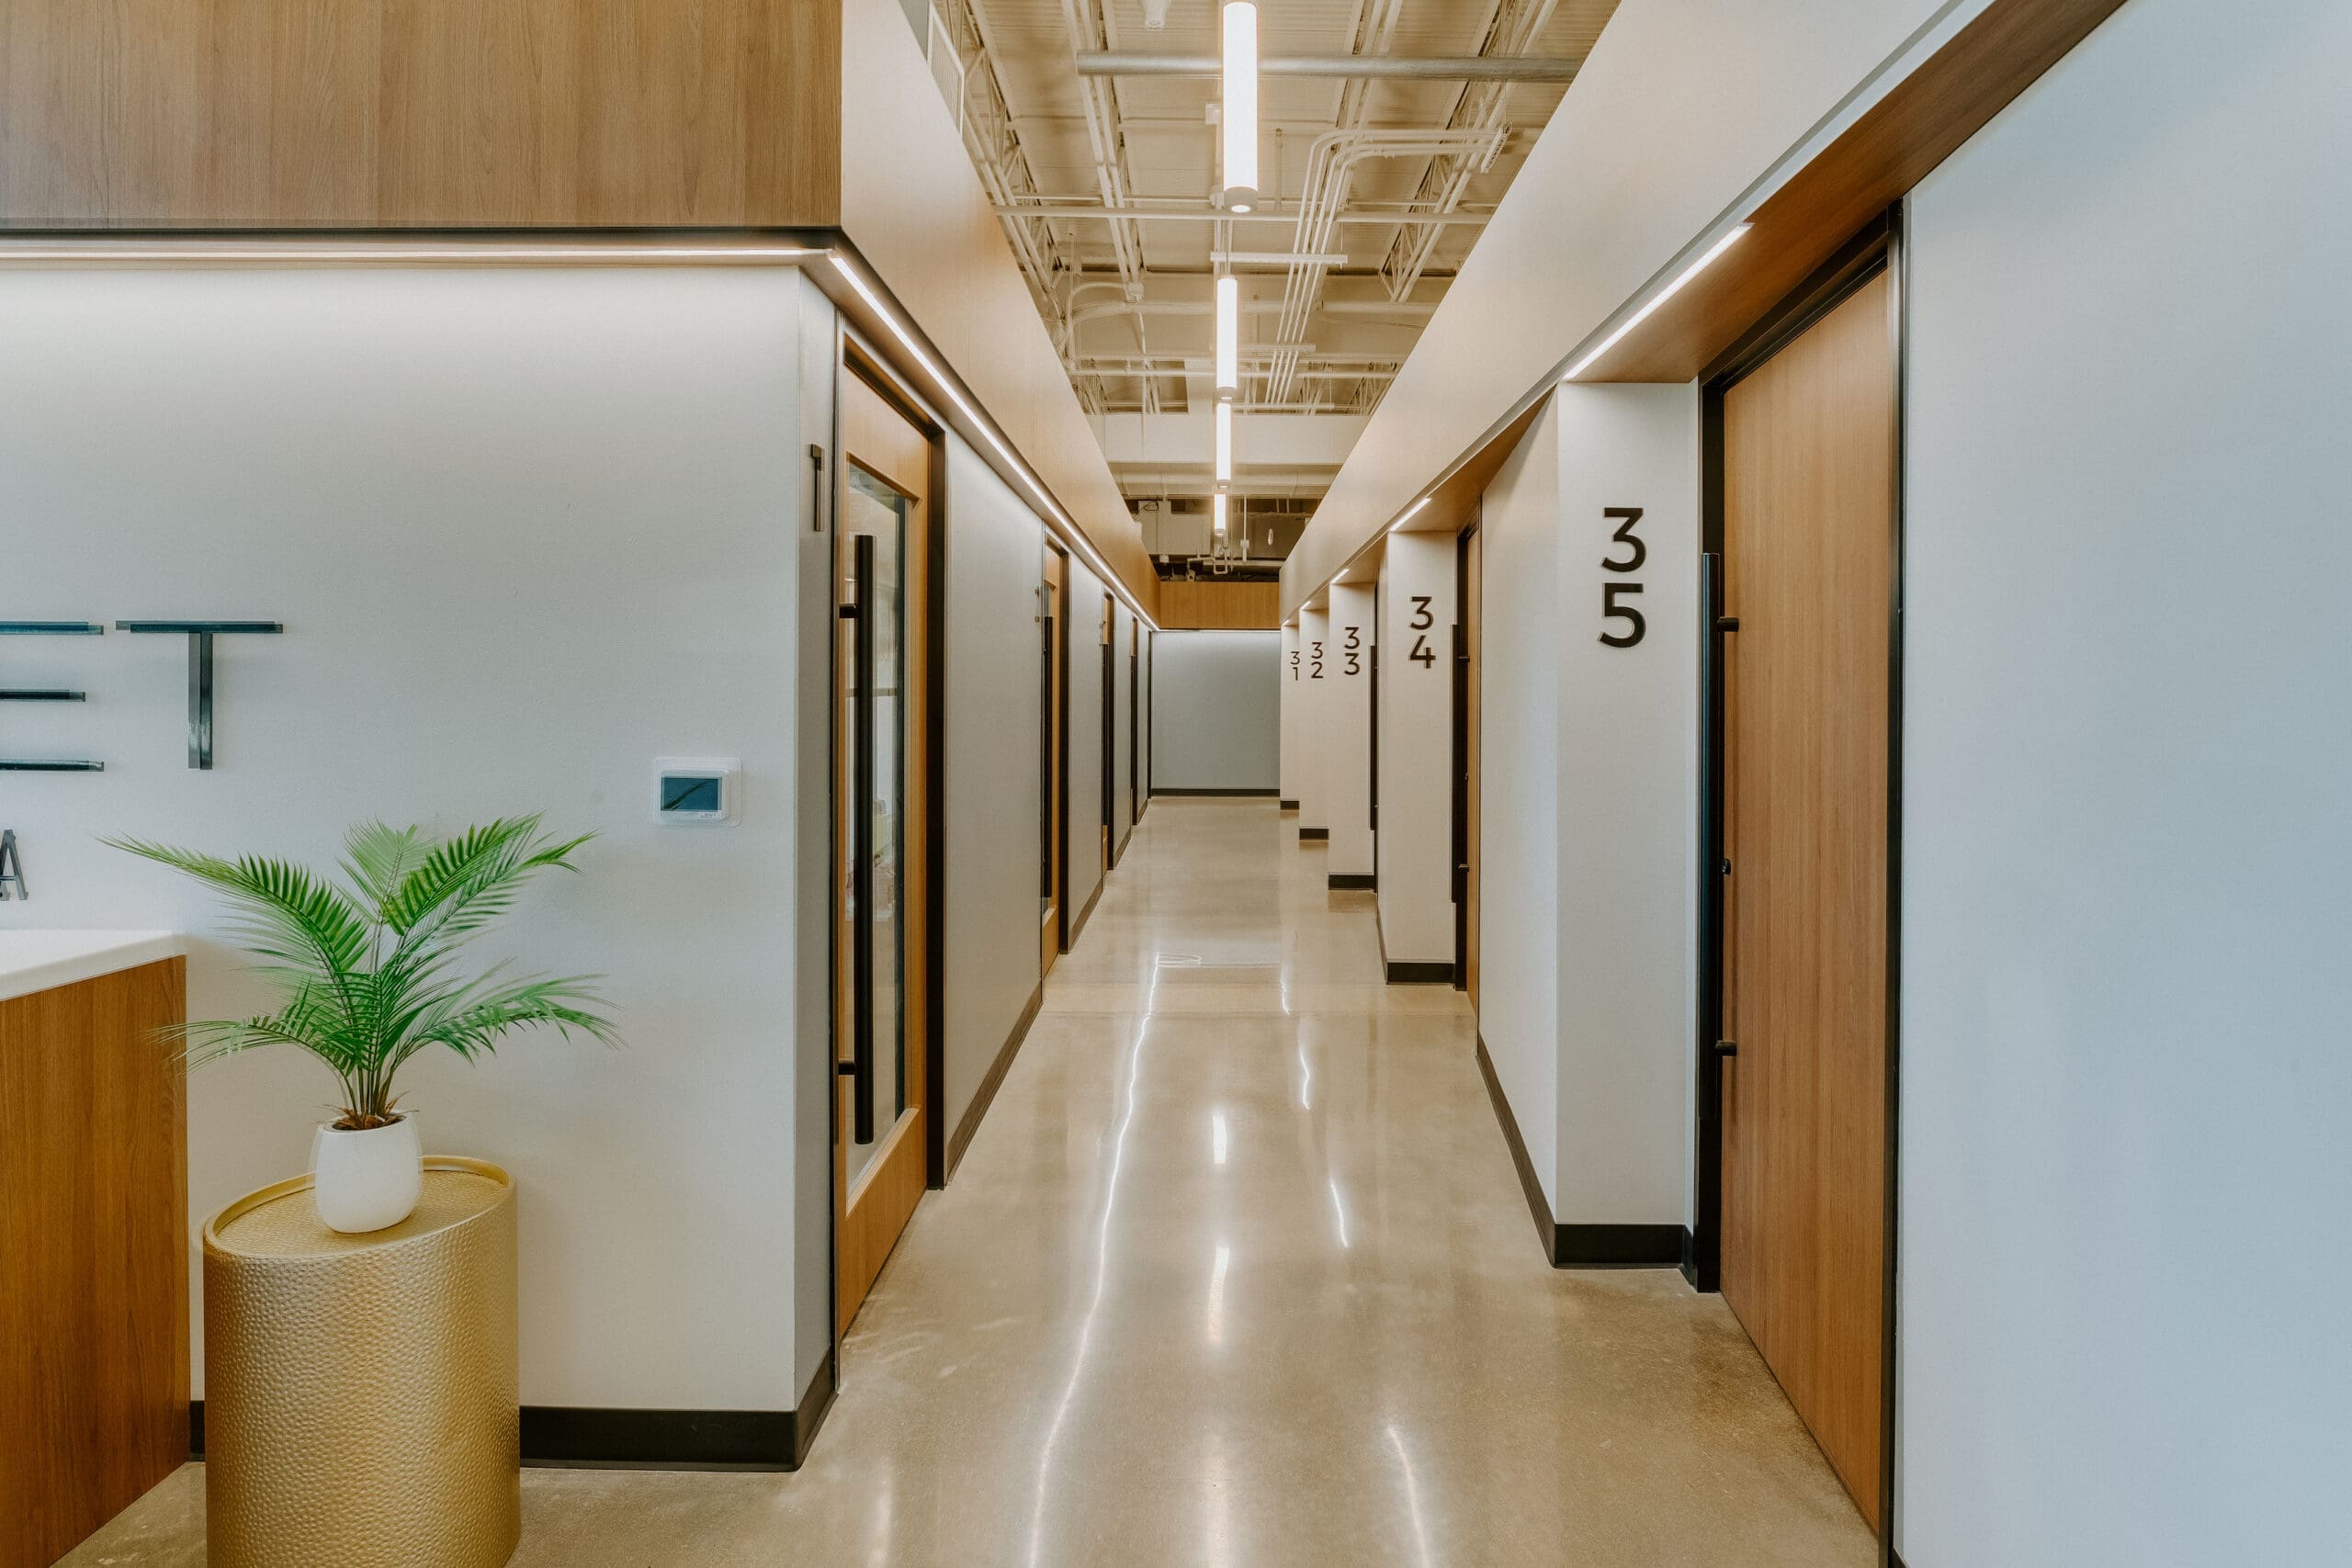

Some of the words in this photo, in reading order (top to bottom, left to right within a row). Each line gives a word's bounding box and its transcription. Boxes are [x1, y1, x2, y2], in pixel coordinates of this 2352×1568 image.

[1598, 507, 1646, 649] 35
[1344, 626, 1361, 676] 33
[1409, 596, 1437, 670] 34
[1290, 651, 1301, 681] 31
[1311, 642, 1324, 679] 32
